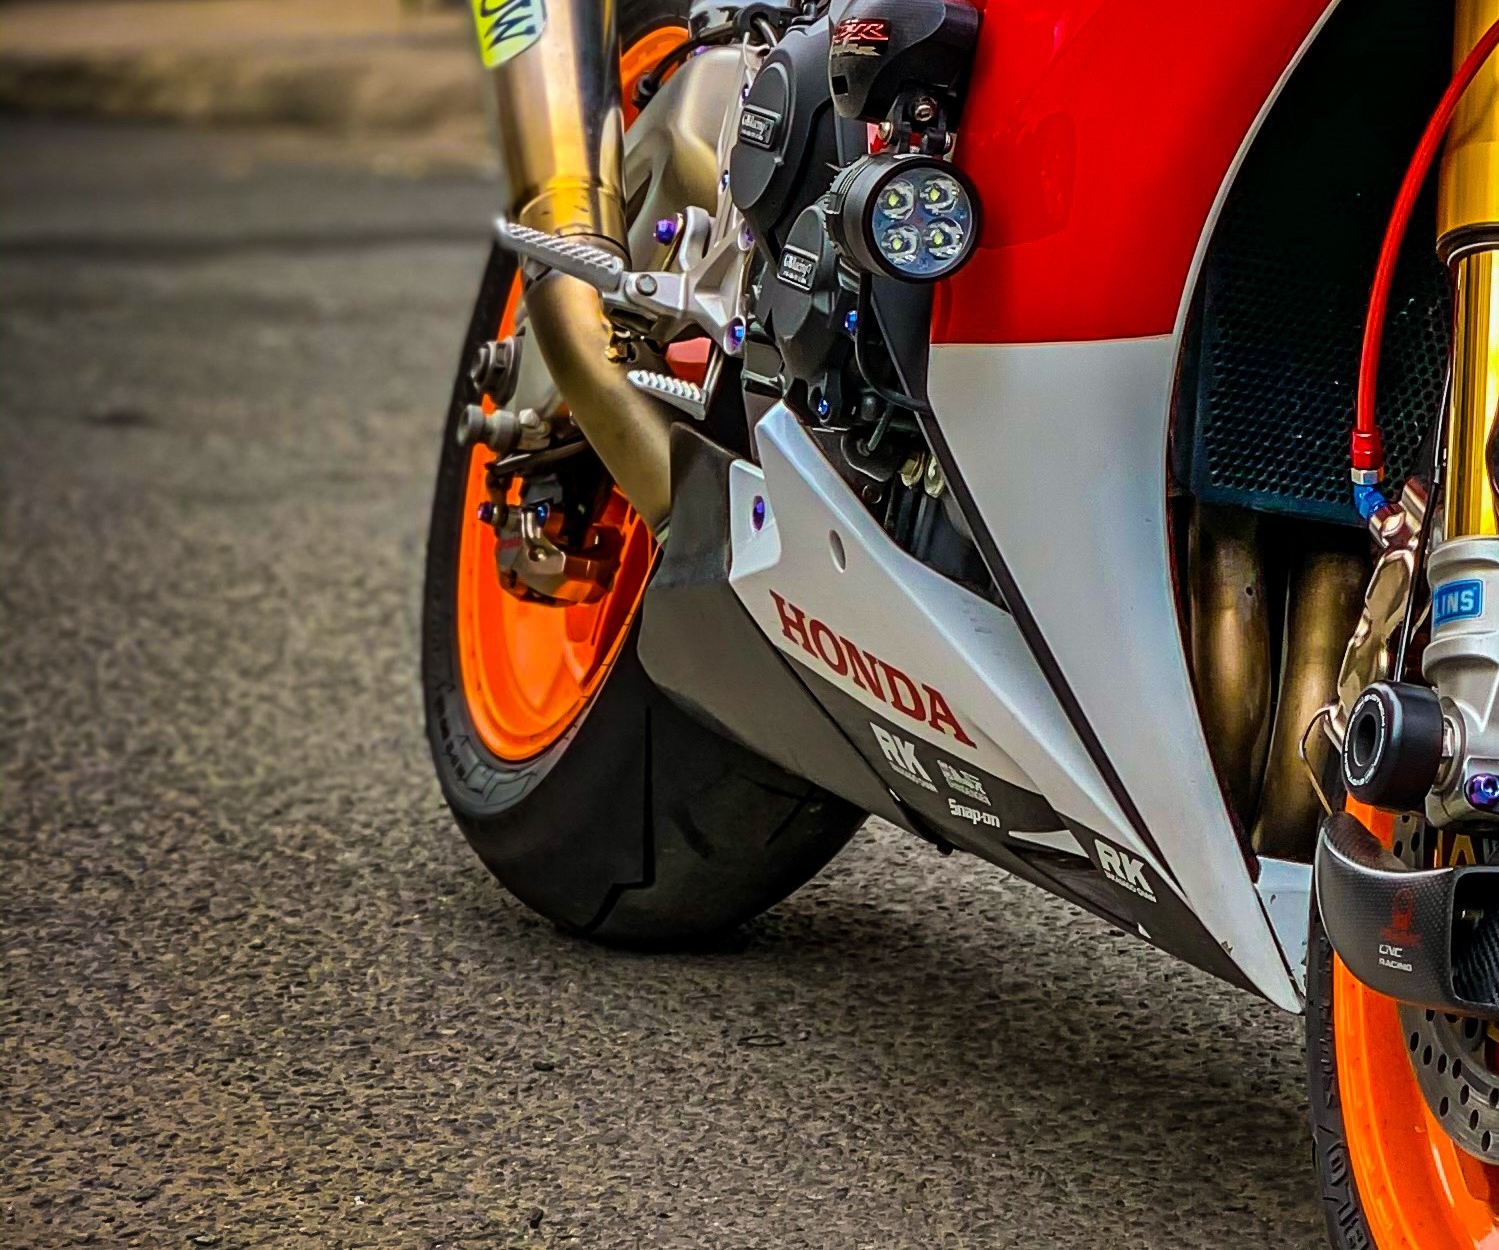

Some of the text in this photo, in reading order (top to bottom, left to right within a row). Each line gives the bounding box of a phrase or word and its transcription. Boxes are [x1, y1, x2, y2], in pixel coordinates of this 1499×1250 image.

[769, 589, 978, 749] HONDA
[870, 721, 932, 782] RK
[948, 798, 1001, 828] Snap-on
[1094, 838, 1154, 894] RK
